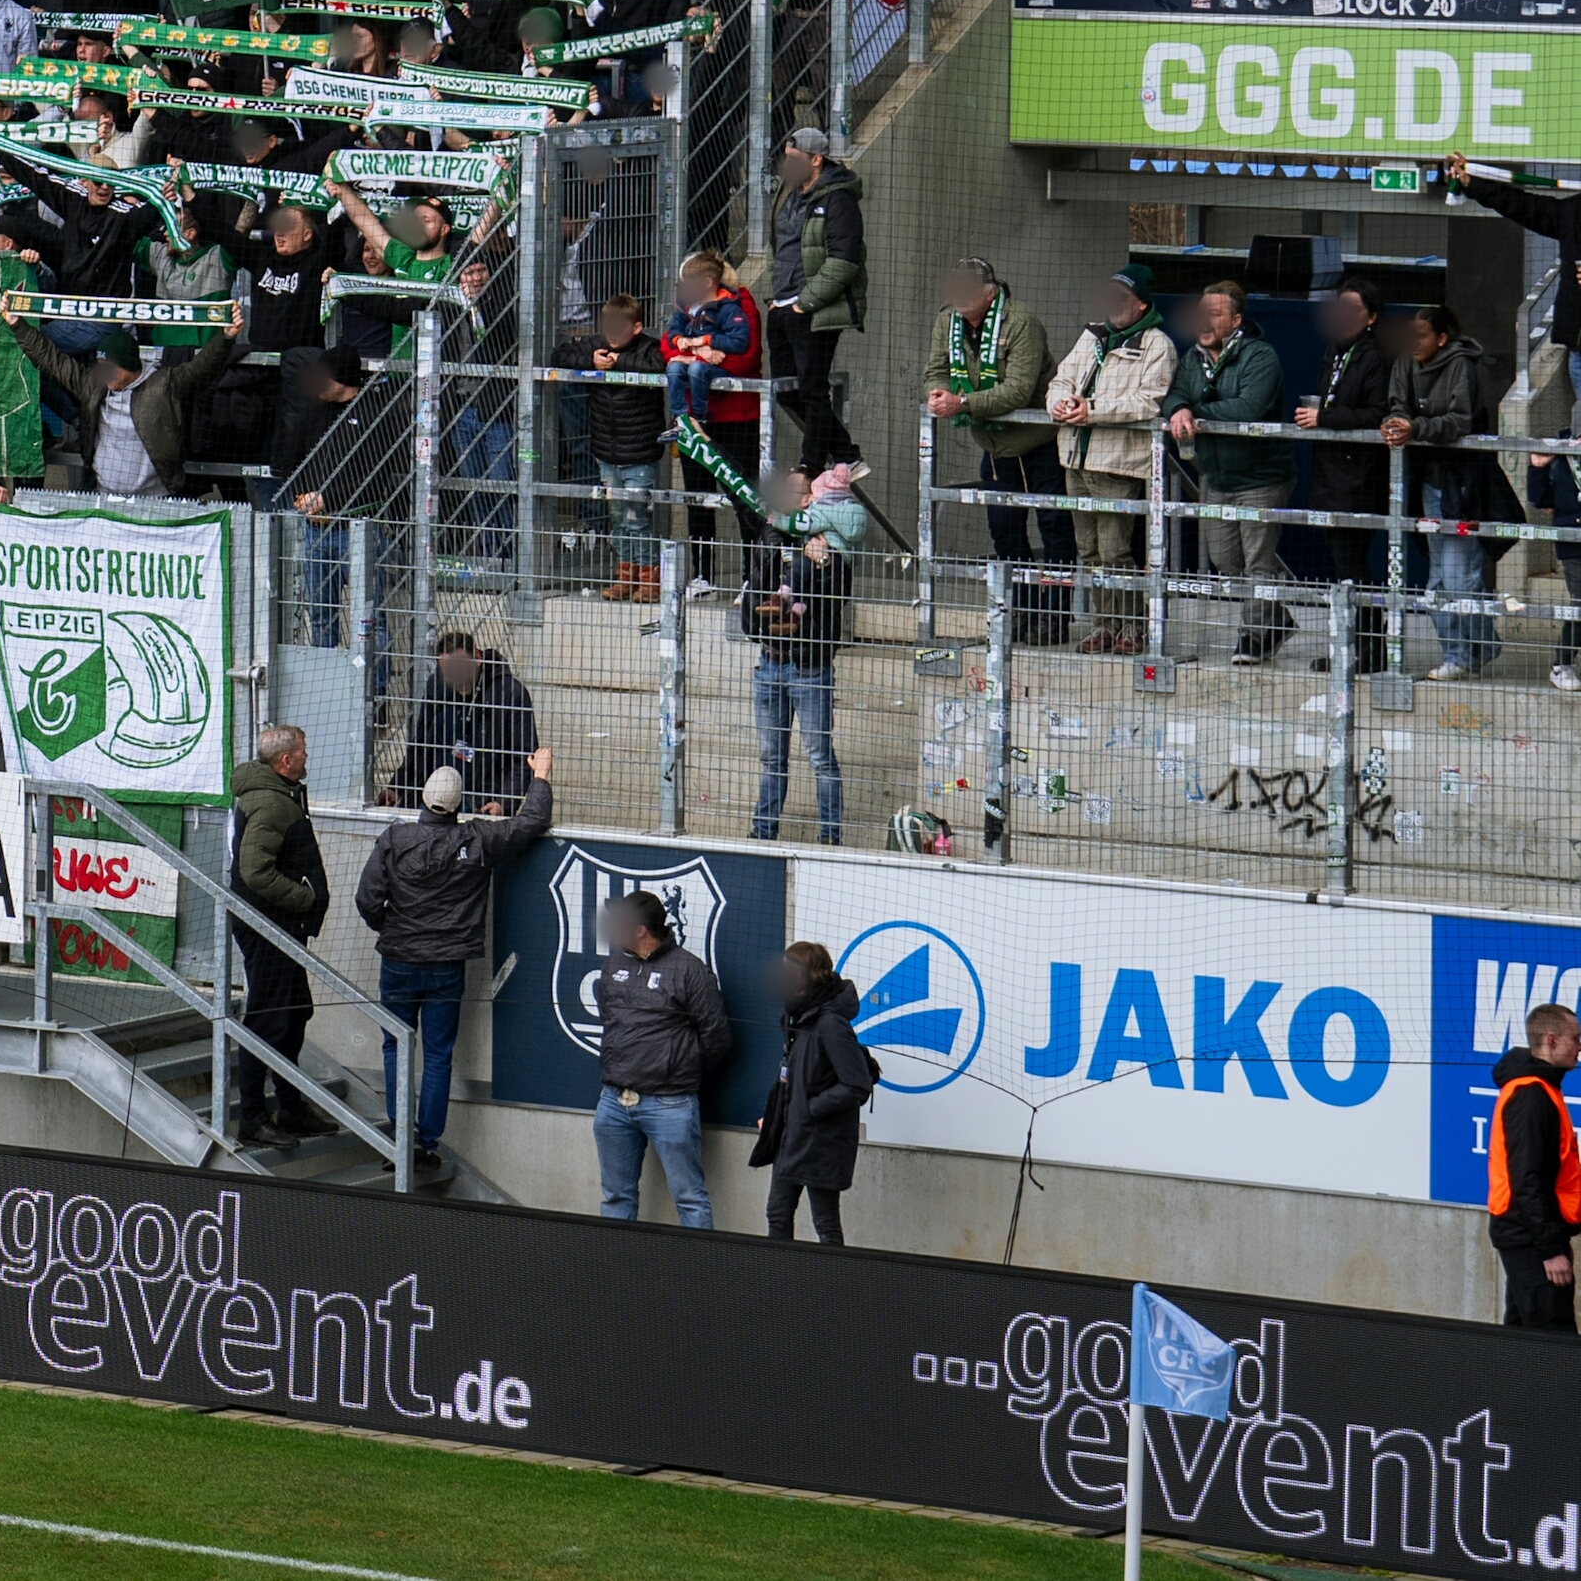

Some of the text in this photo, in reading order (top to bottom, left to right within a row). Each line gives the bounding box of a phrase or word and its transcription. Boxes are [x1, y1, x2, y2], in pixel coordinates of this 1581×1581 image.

[1142, 41, 1534, 147] GGG.DE
[350, 151, 489, 183] CHEMIE LEIPZIG
[42, 299, 195, 322] LEUTZSCH
[1025, 960, 1391, 1109] JAKO
